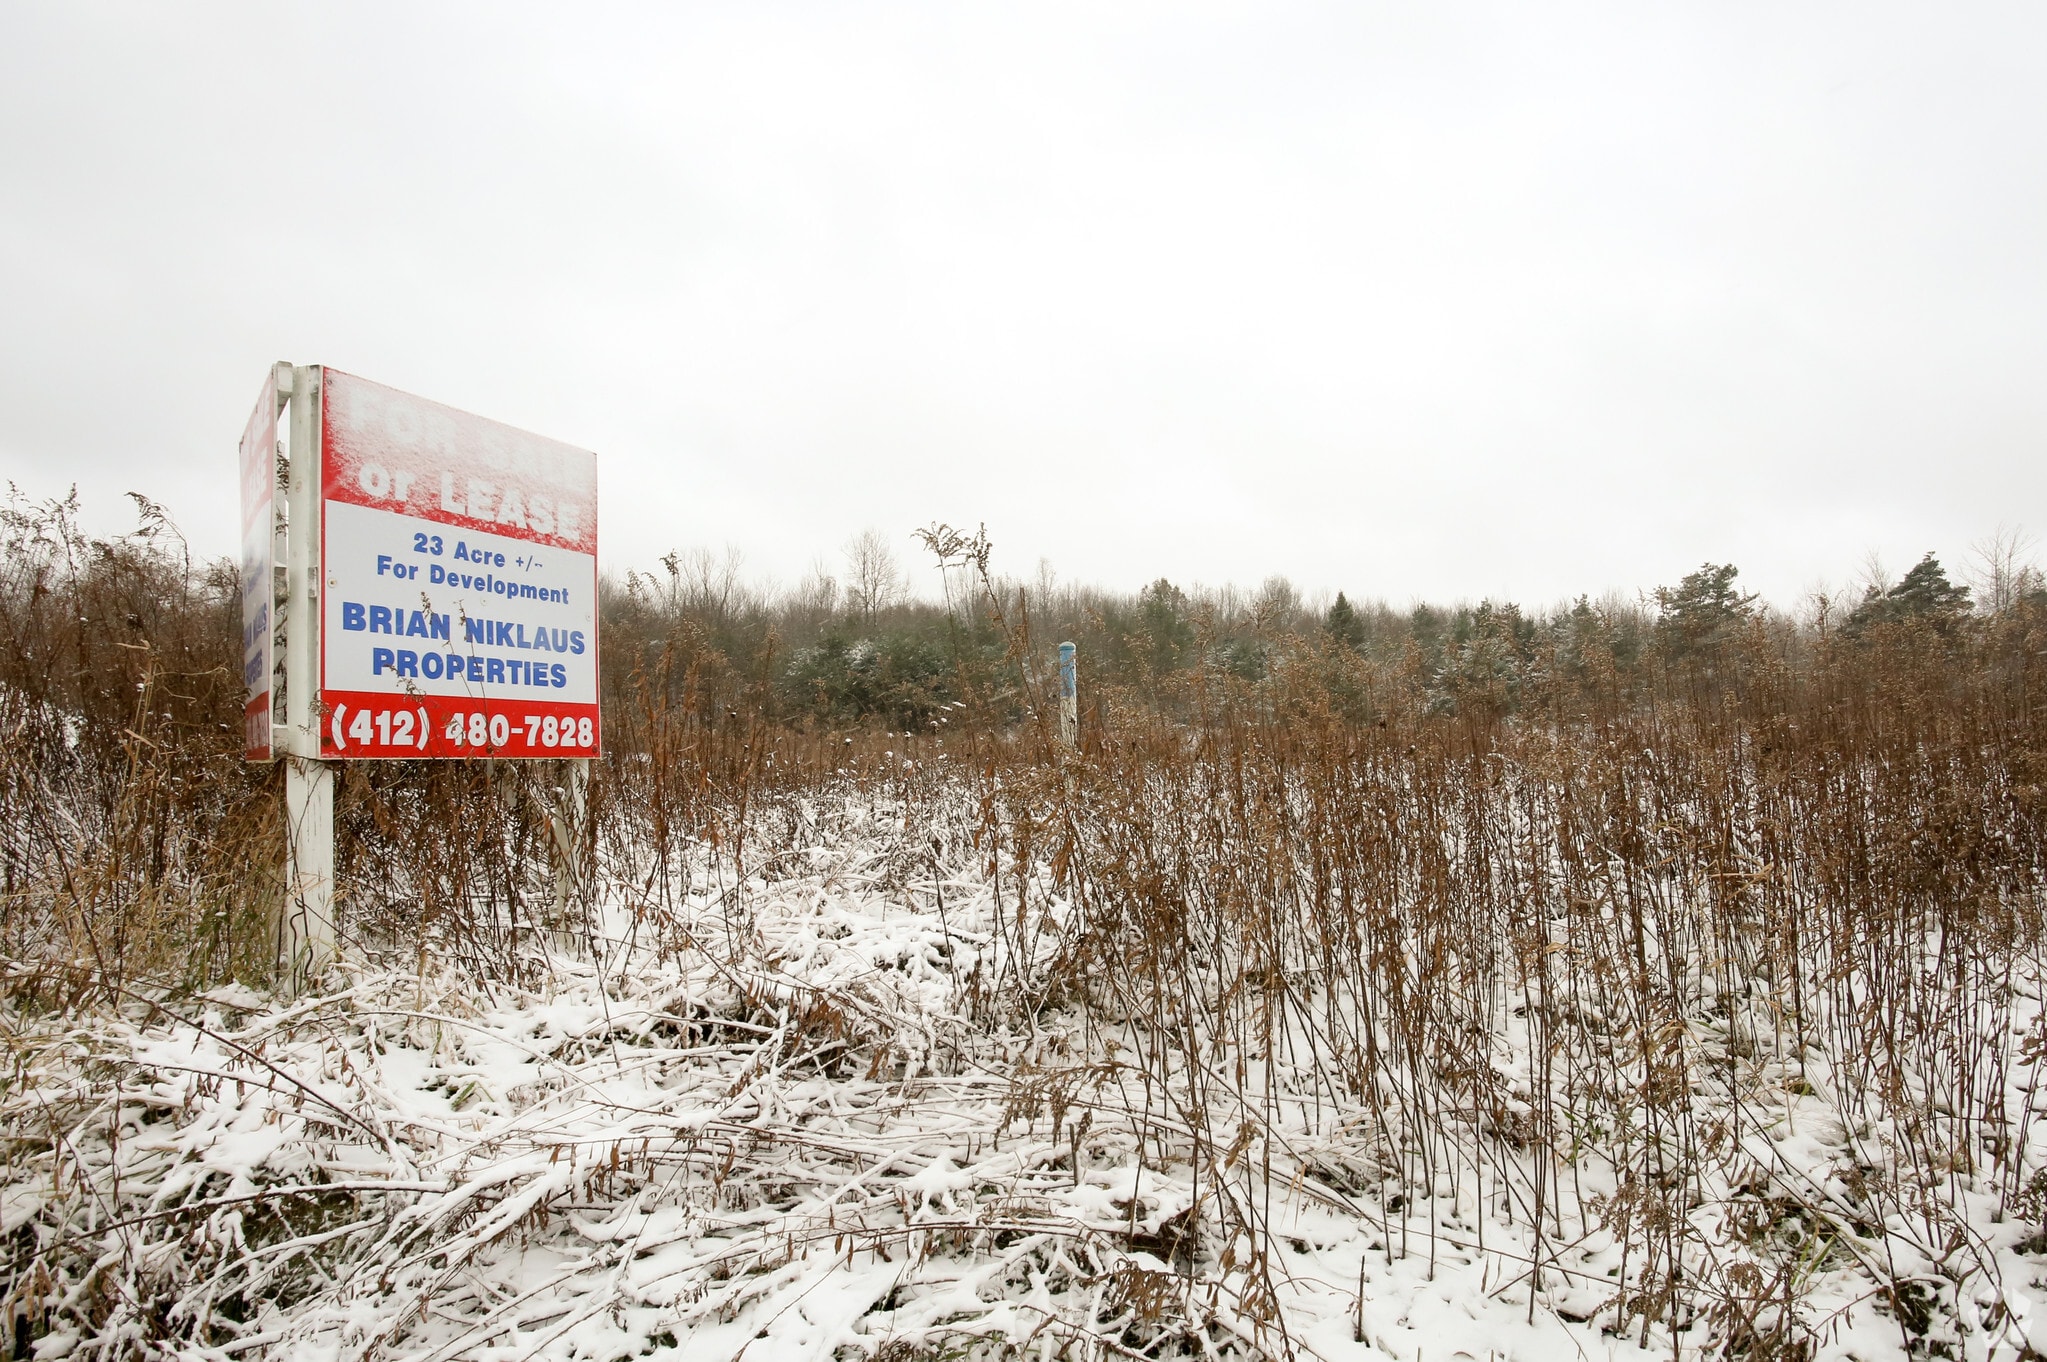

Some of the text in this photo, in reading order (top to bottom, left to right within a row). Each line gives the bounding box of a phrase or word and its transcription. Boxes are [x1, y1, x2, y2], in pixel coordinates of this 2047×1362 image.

[440, 469, 580, 541] LEASE
[413, 532, 444, 556] 23
[454, 541, 506, 568] Acre
[377, 555, 569, 605] For Development
[342, 601, 586, 655] BRIAN NIKLAUS
[372, 647, 567, 689] PROPERTIES
[331, 702, 594, 751] (412) 480-7828
